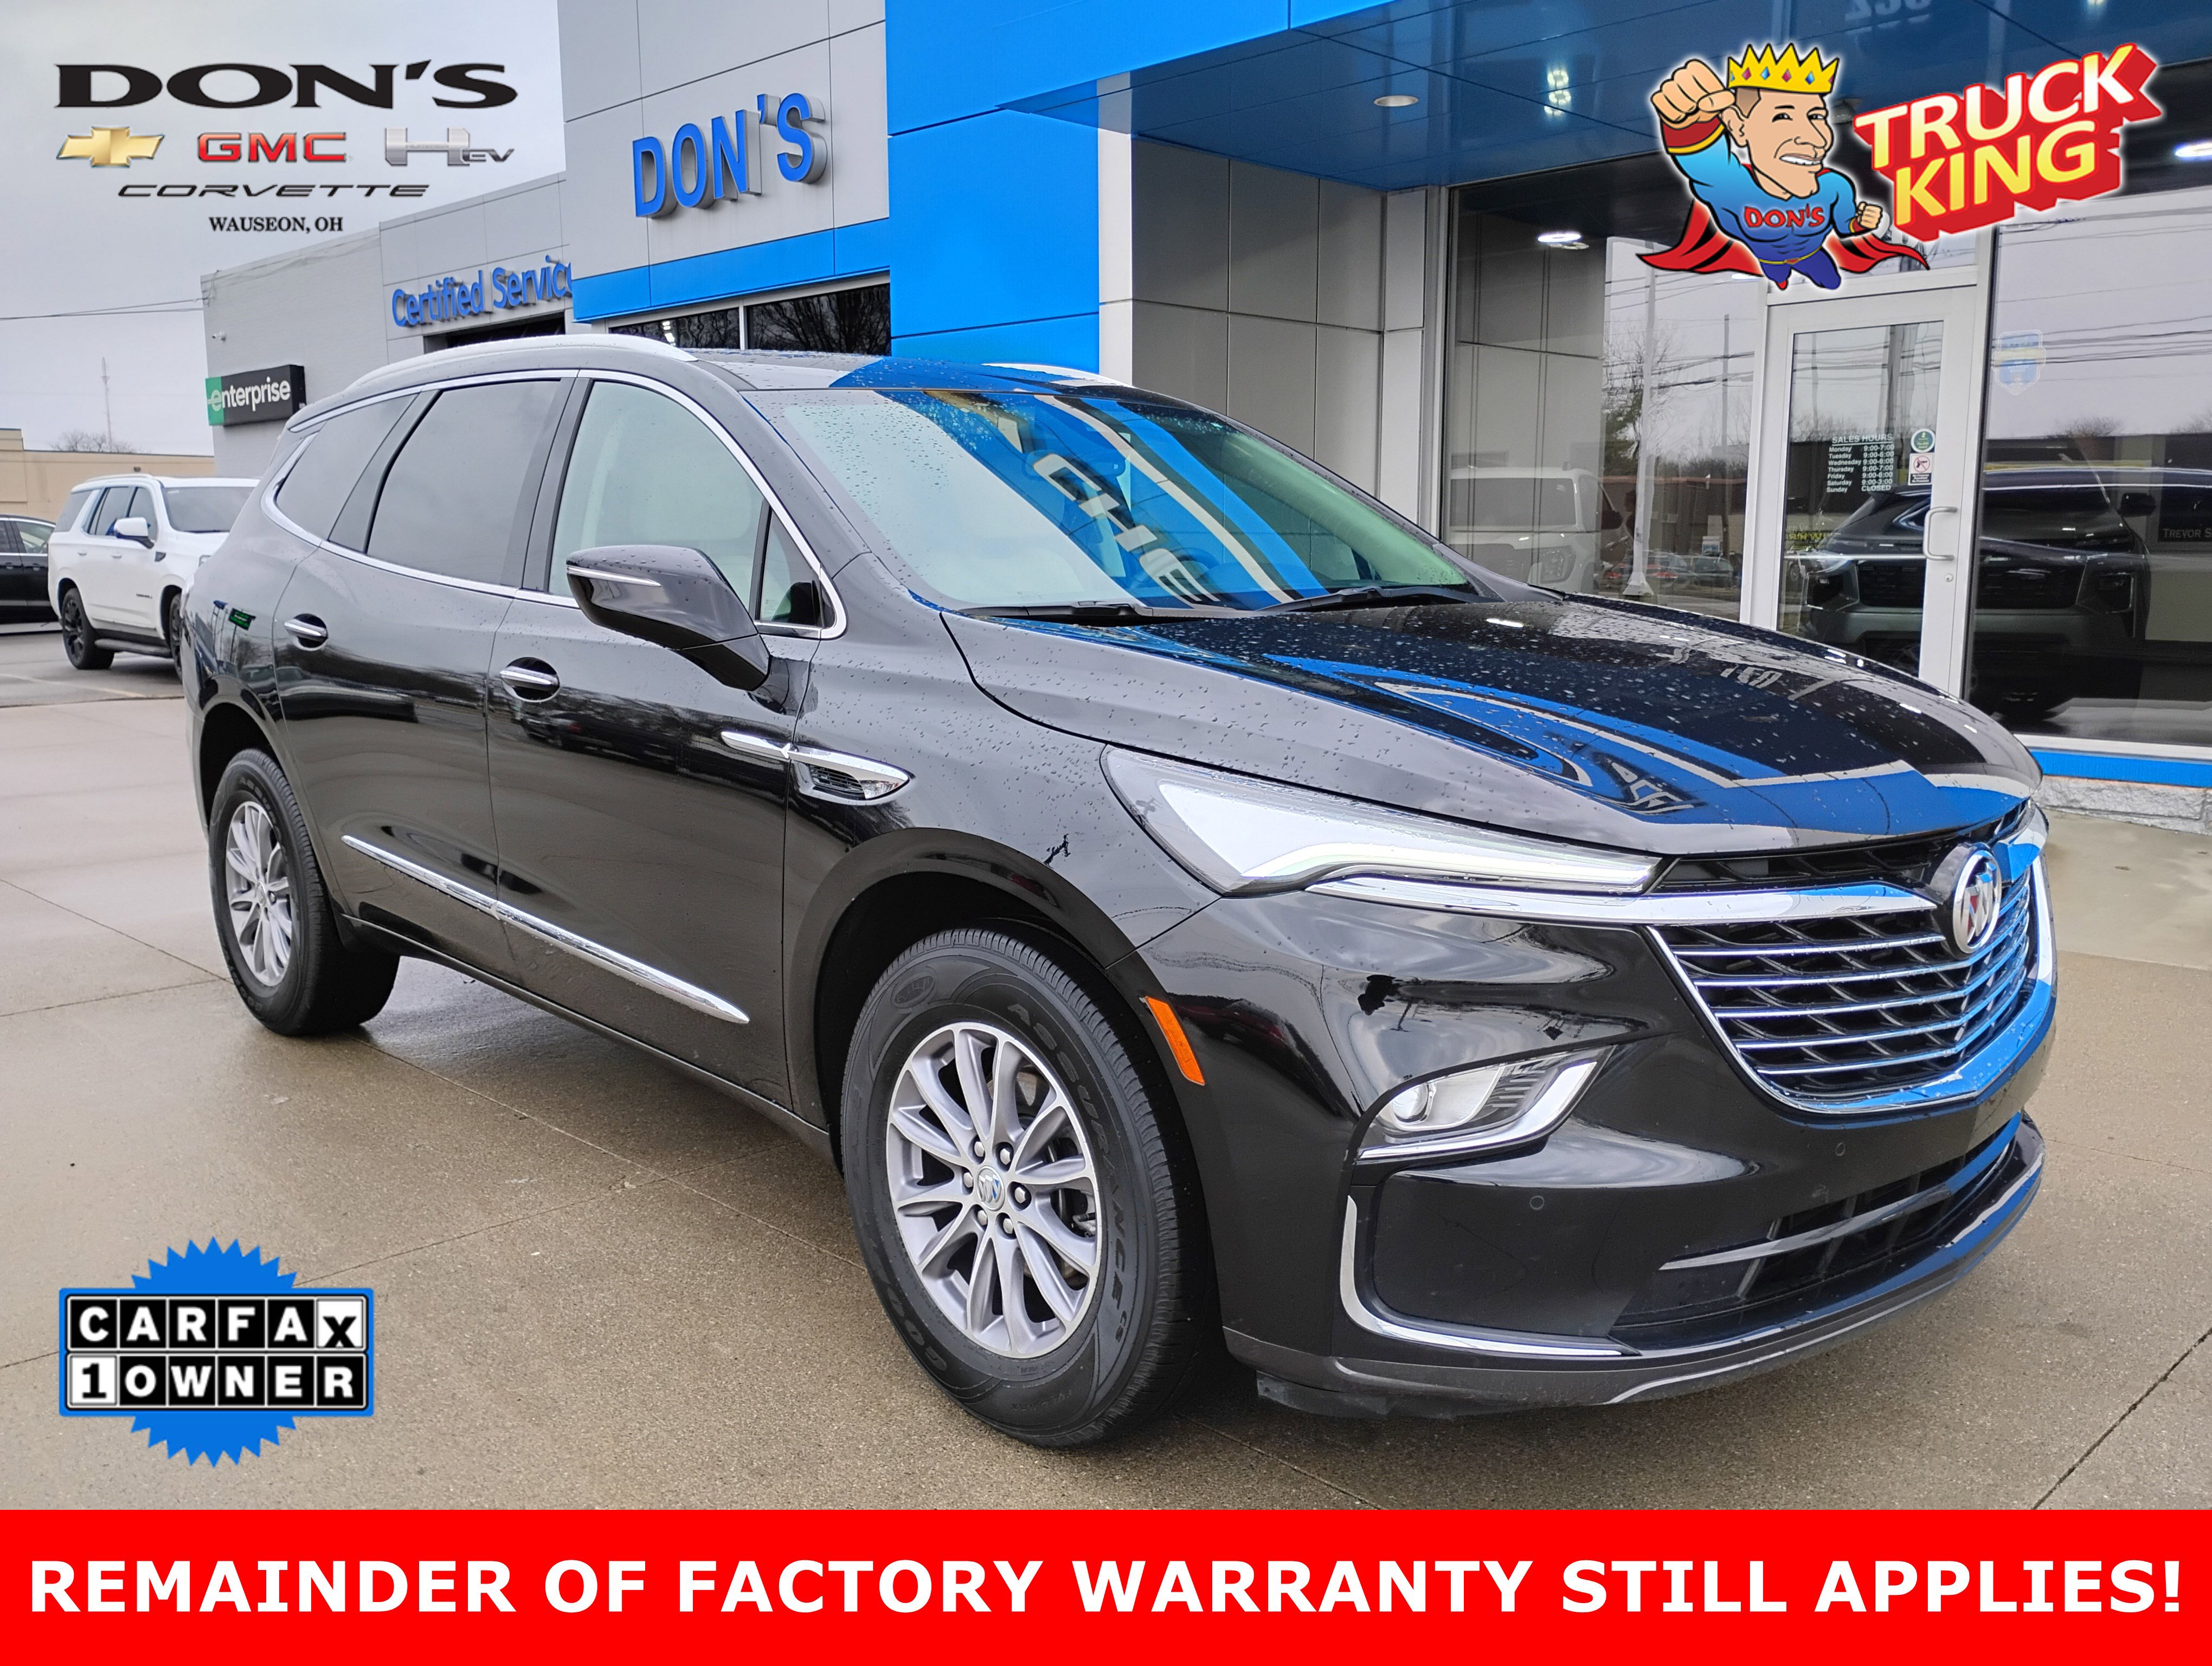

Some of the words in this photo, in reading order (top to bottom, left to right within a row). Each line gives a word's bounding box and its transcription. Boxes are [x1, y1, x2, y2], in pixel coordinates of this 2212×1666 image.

[632, 92, 819, 217] DON'S
[392, 270, 485, 328] Certified
[210, 376, 291, 412] enterprise
[1832, 434, 1860, 444] SALES
[1862, 433, 1893, 442] HOURS
[2163, 528, 2201, 538] TREVOR
